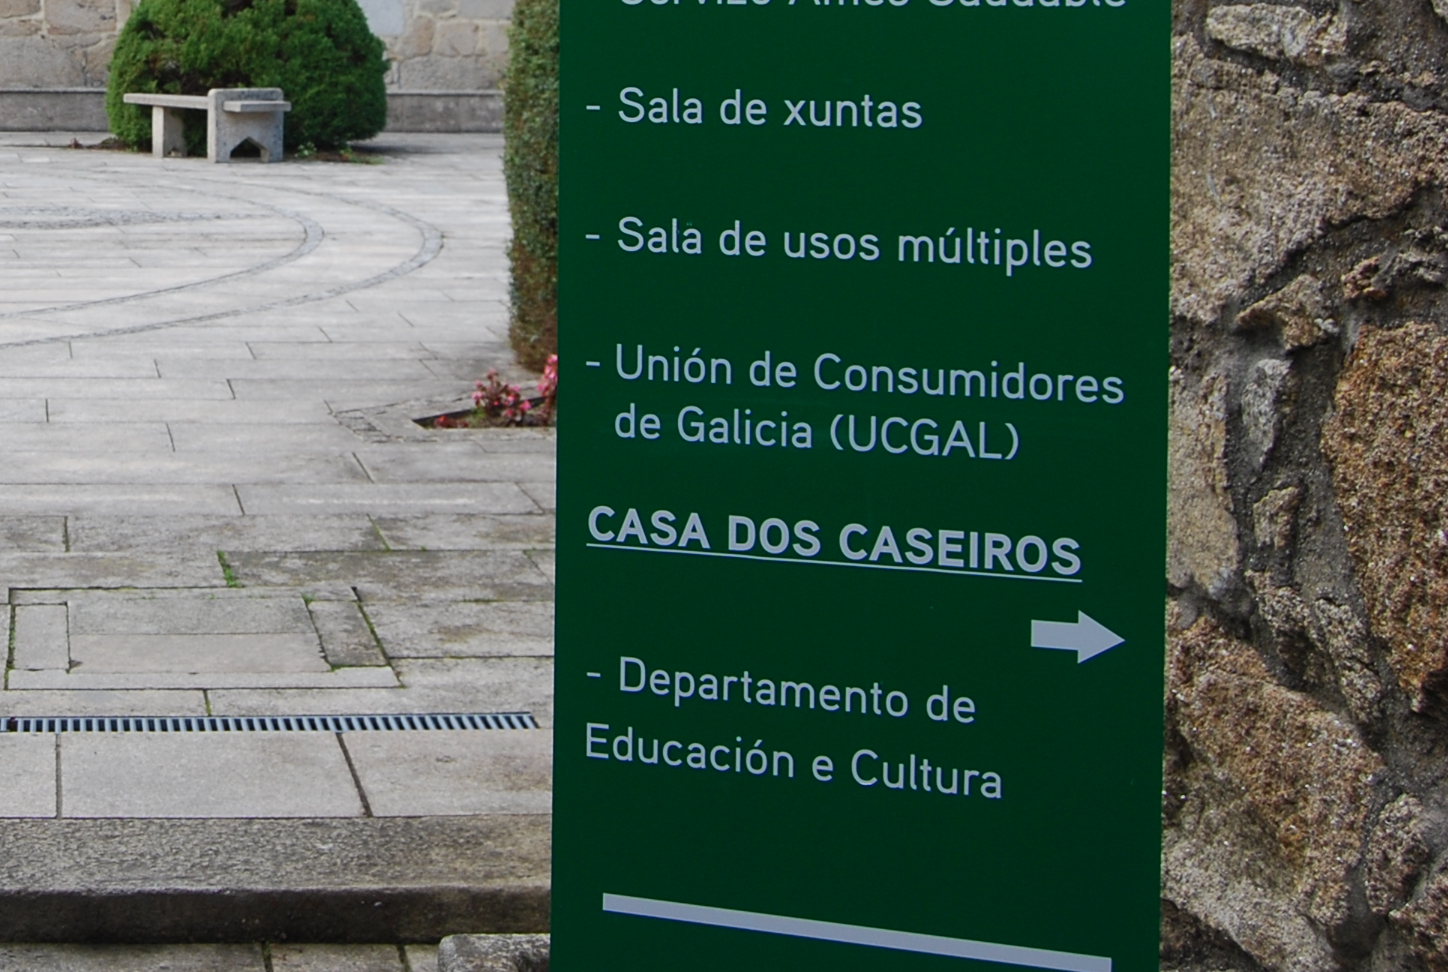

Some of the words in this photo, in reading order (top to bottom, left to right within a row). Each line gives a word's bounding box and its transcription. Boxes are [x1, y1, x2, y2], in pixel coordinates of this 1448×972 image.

[618, 87, 702, 124] Sala
[719, 89, 767, 125] de
[784, 93, 923, 128] xuntas
[617, 216, 702, 254] Sala
[719, 220, 767, 257] de
[784, 232, 880, 261] usos
[897, 226, 1093, 277] múltiples
[616, 343, 732, 384] Unión
[749, 350, 797, 387] de
[813, 353, 1125, 404] Consumidores
[614, 403, 661, 439] de
[677, 406, 812, 449] Galicia
[829, 414, 1019, 460] (UCGAL)
[588, 505, 710, 549] CASA
[728, 515, 821, 556] DOS
[839, 523, 1082, 575] CASEIROS
[619, 656, 909, 717] Departamento
[925, 685, 976, 724] de
[585, 722, 794, 778] Educación
[811, 755, 834, 782] e
[850, 749, 1002, 798] Cultura
